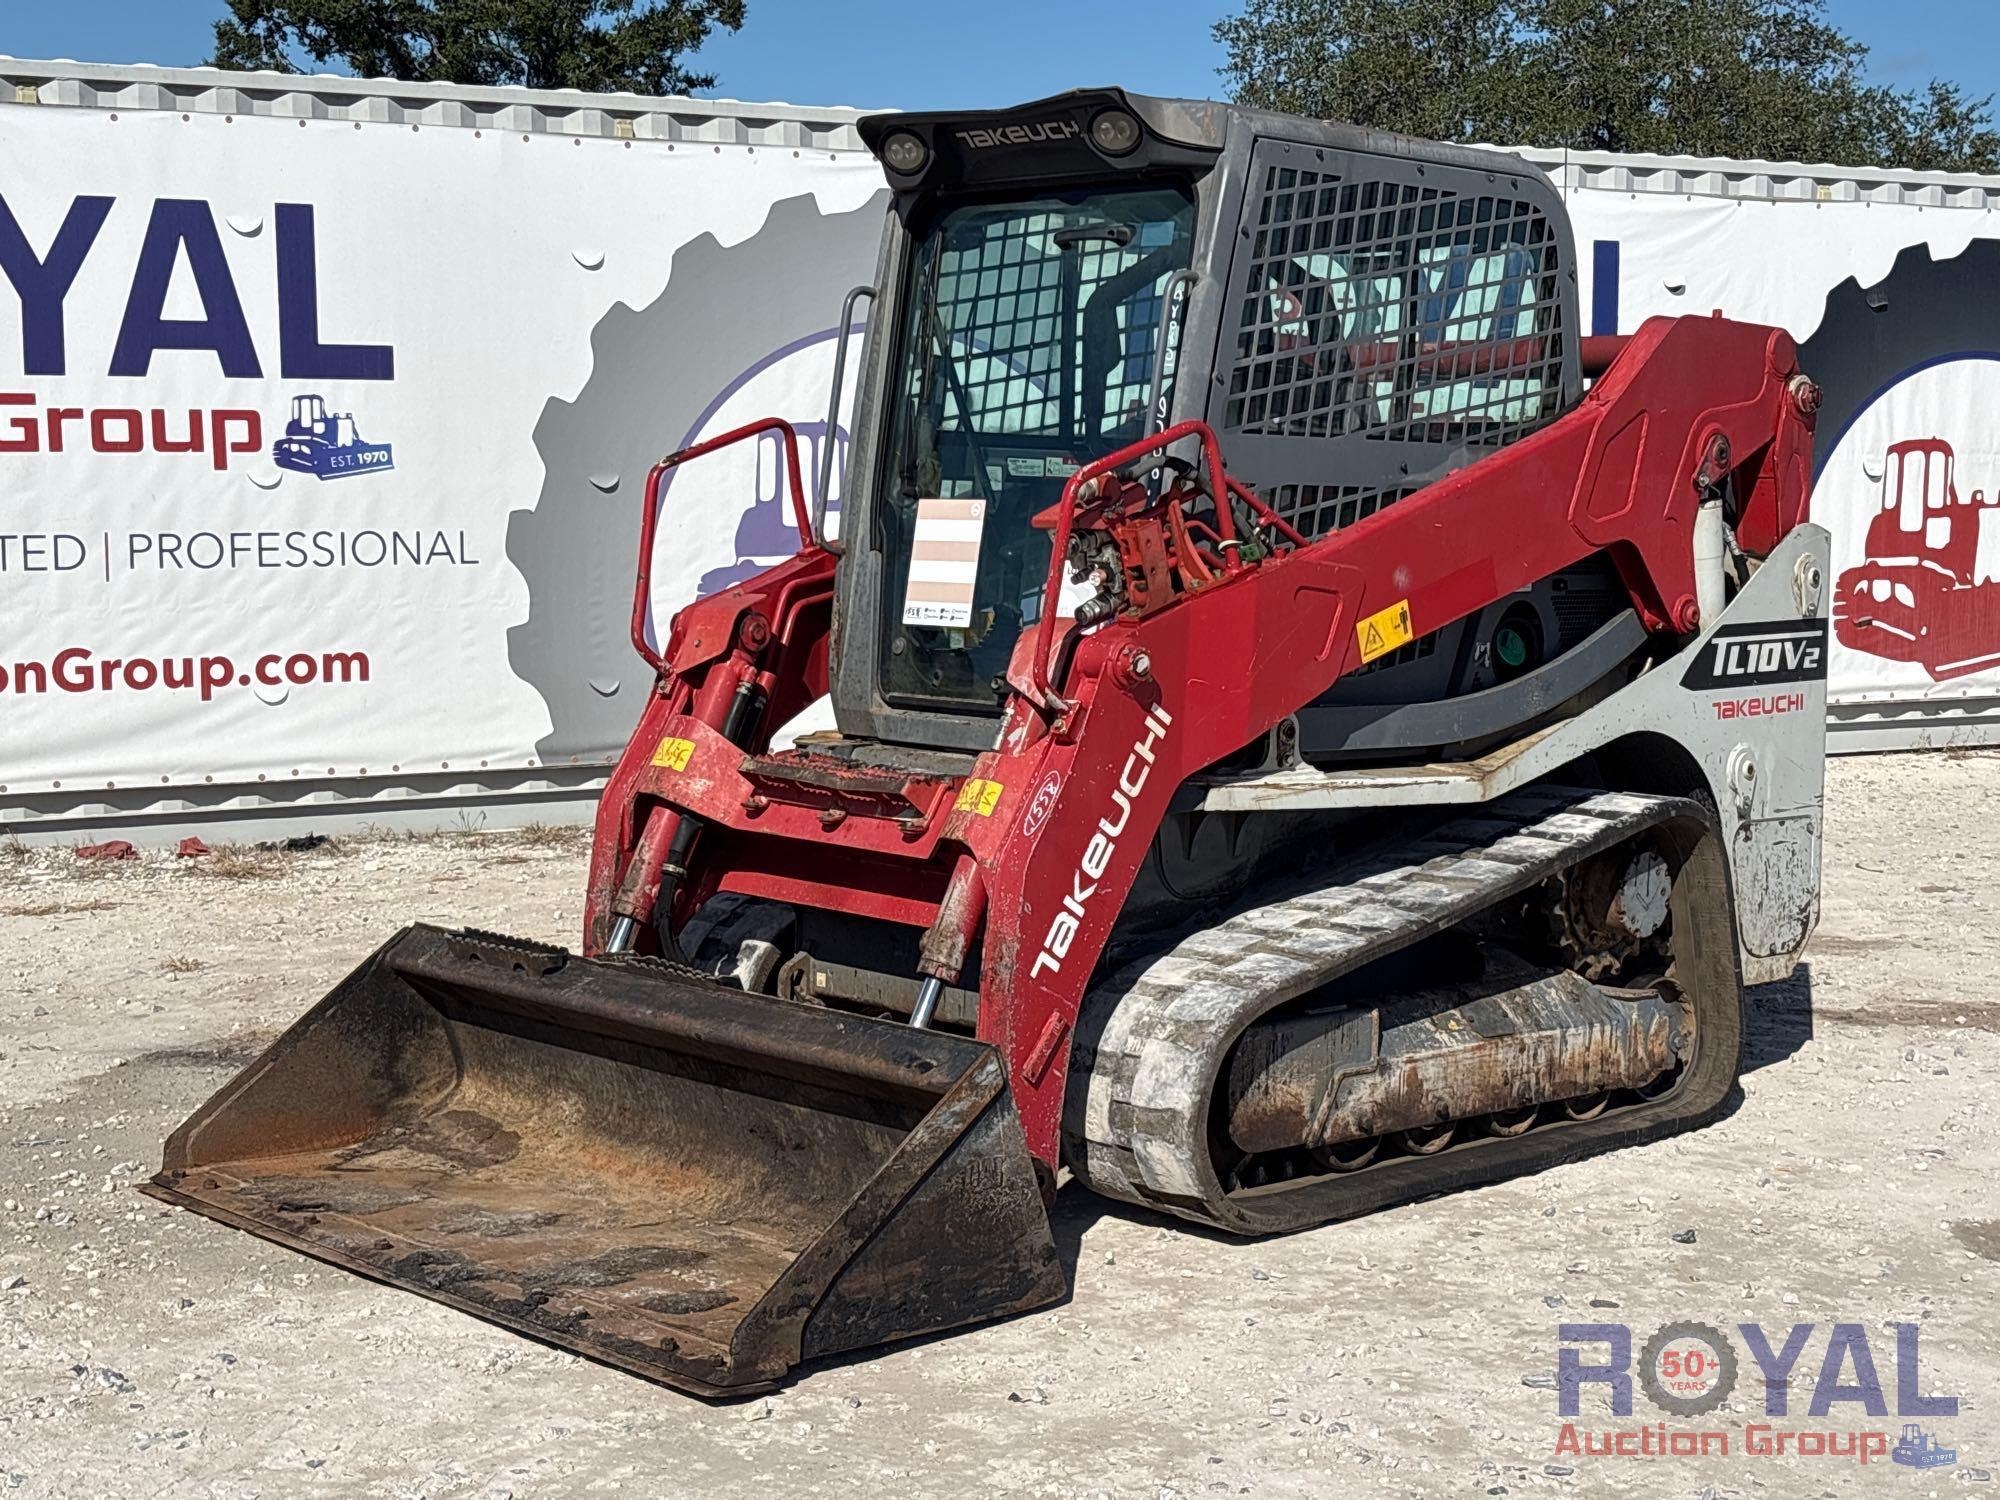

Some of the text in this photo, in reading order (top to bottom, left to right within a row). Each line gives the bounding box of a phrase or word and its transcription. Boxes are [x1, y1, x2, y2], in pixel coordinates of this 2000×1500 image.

[955, 120, 1083, 148] TAKEUCH
[0, 192, 394, 380] YAL
[0, 392, 262, 470] Group
[330, 451, 388, 468] EST. 1970
[129, 530, 480, 570] PROFESSIONAL
[0, 647, 370, 701] nGroup.com
